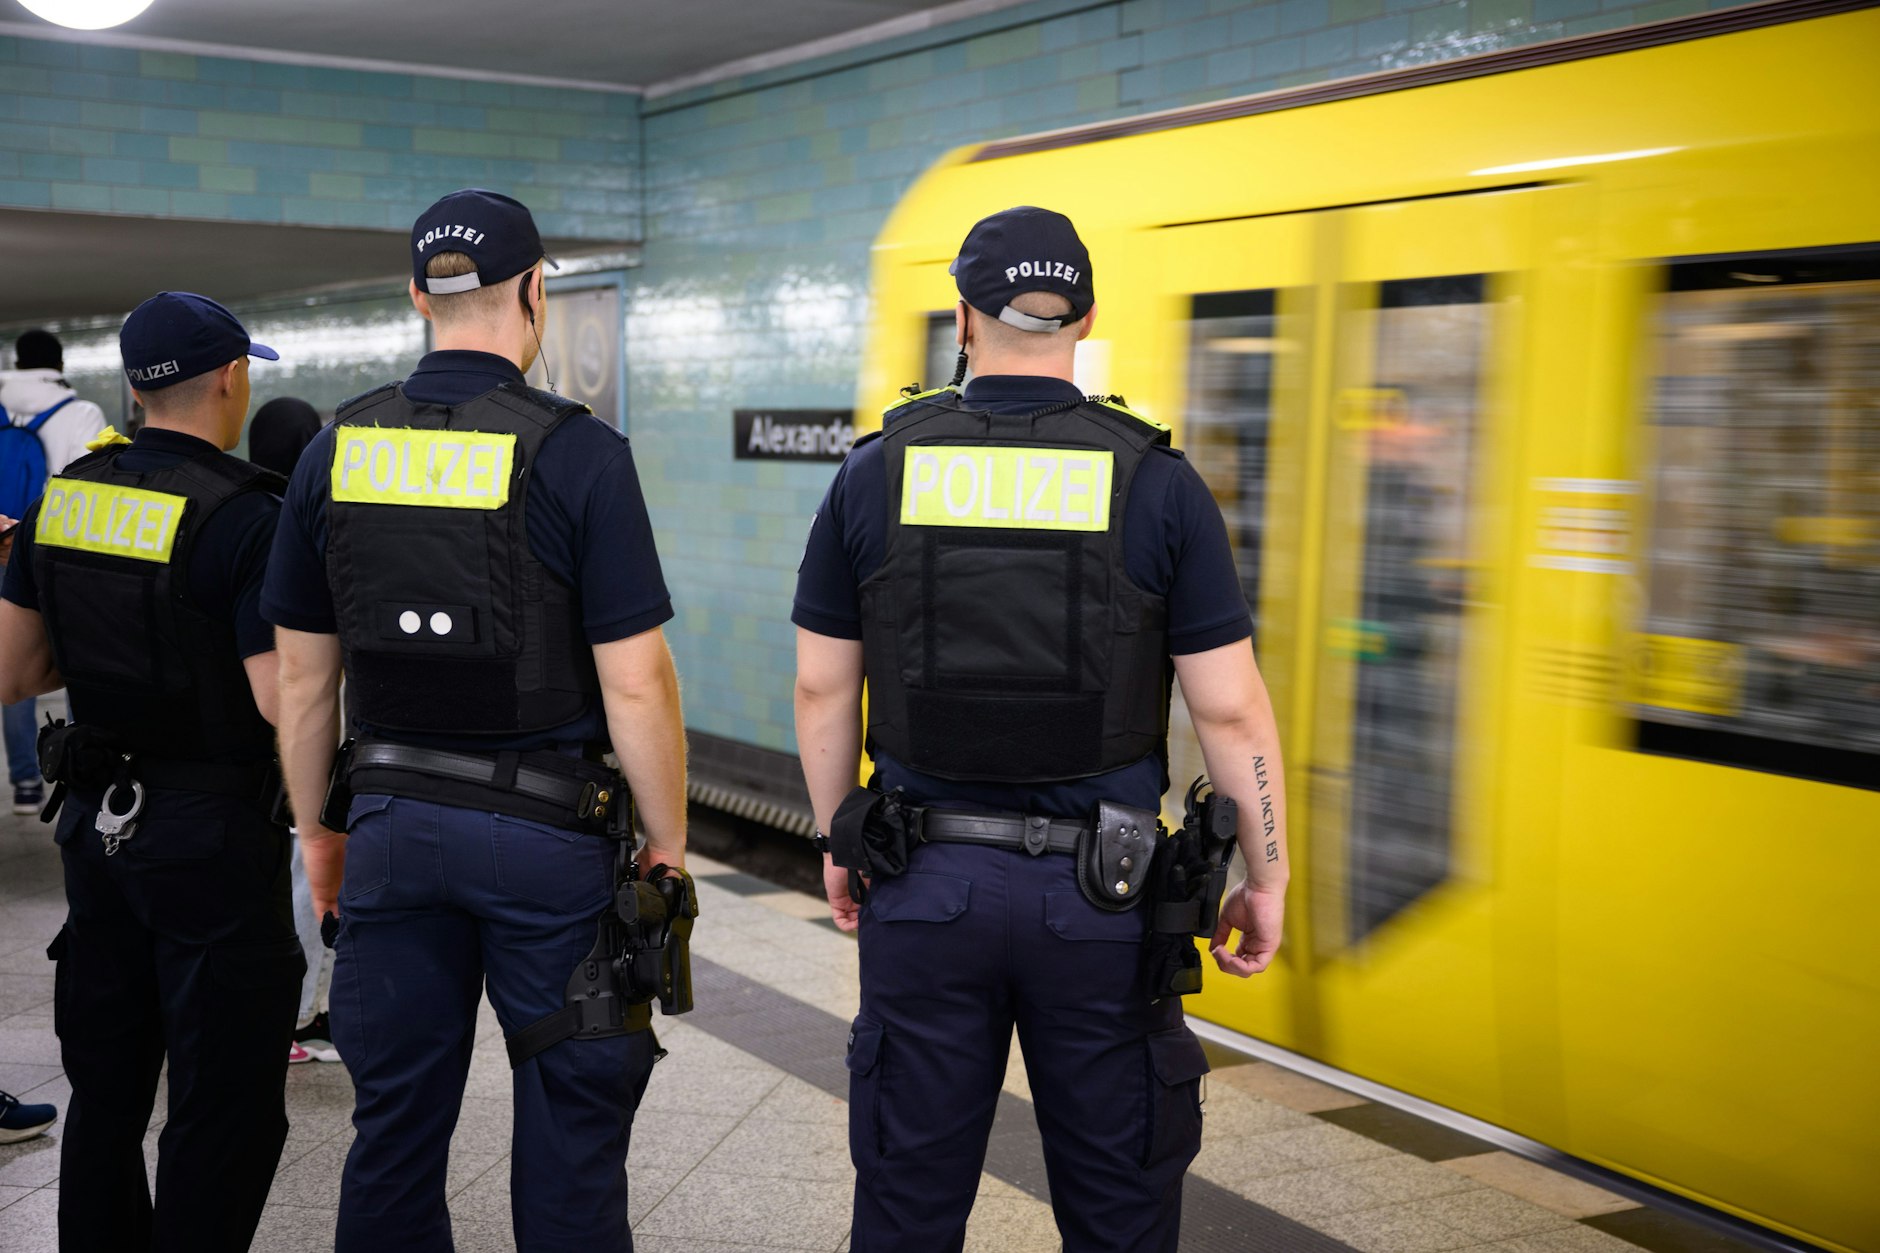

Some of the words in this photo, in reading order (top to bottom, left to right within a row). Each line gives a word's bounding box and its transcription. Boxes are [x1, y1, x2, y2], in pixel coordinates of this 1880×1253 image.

[416, 224, 485, 253] POLIZEI
[1004, 260, 1080, 285] POLIZEI
[127, 359, 180, 381] POLIZEI
[340, 439, 505, 497] POLIZEI
[908, 453, 1105, 524] POLIZEI
[41, 488, 174, 553] POLIZEI
[1252, 756, 1268, 791] ALEA
[1260, 794, 1275, 837] IACTA
[1265, 840, 1279, 863] EST
